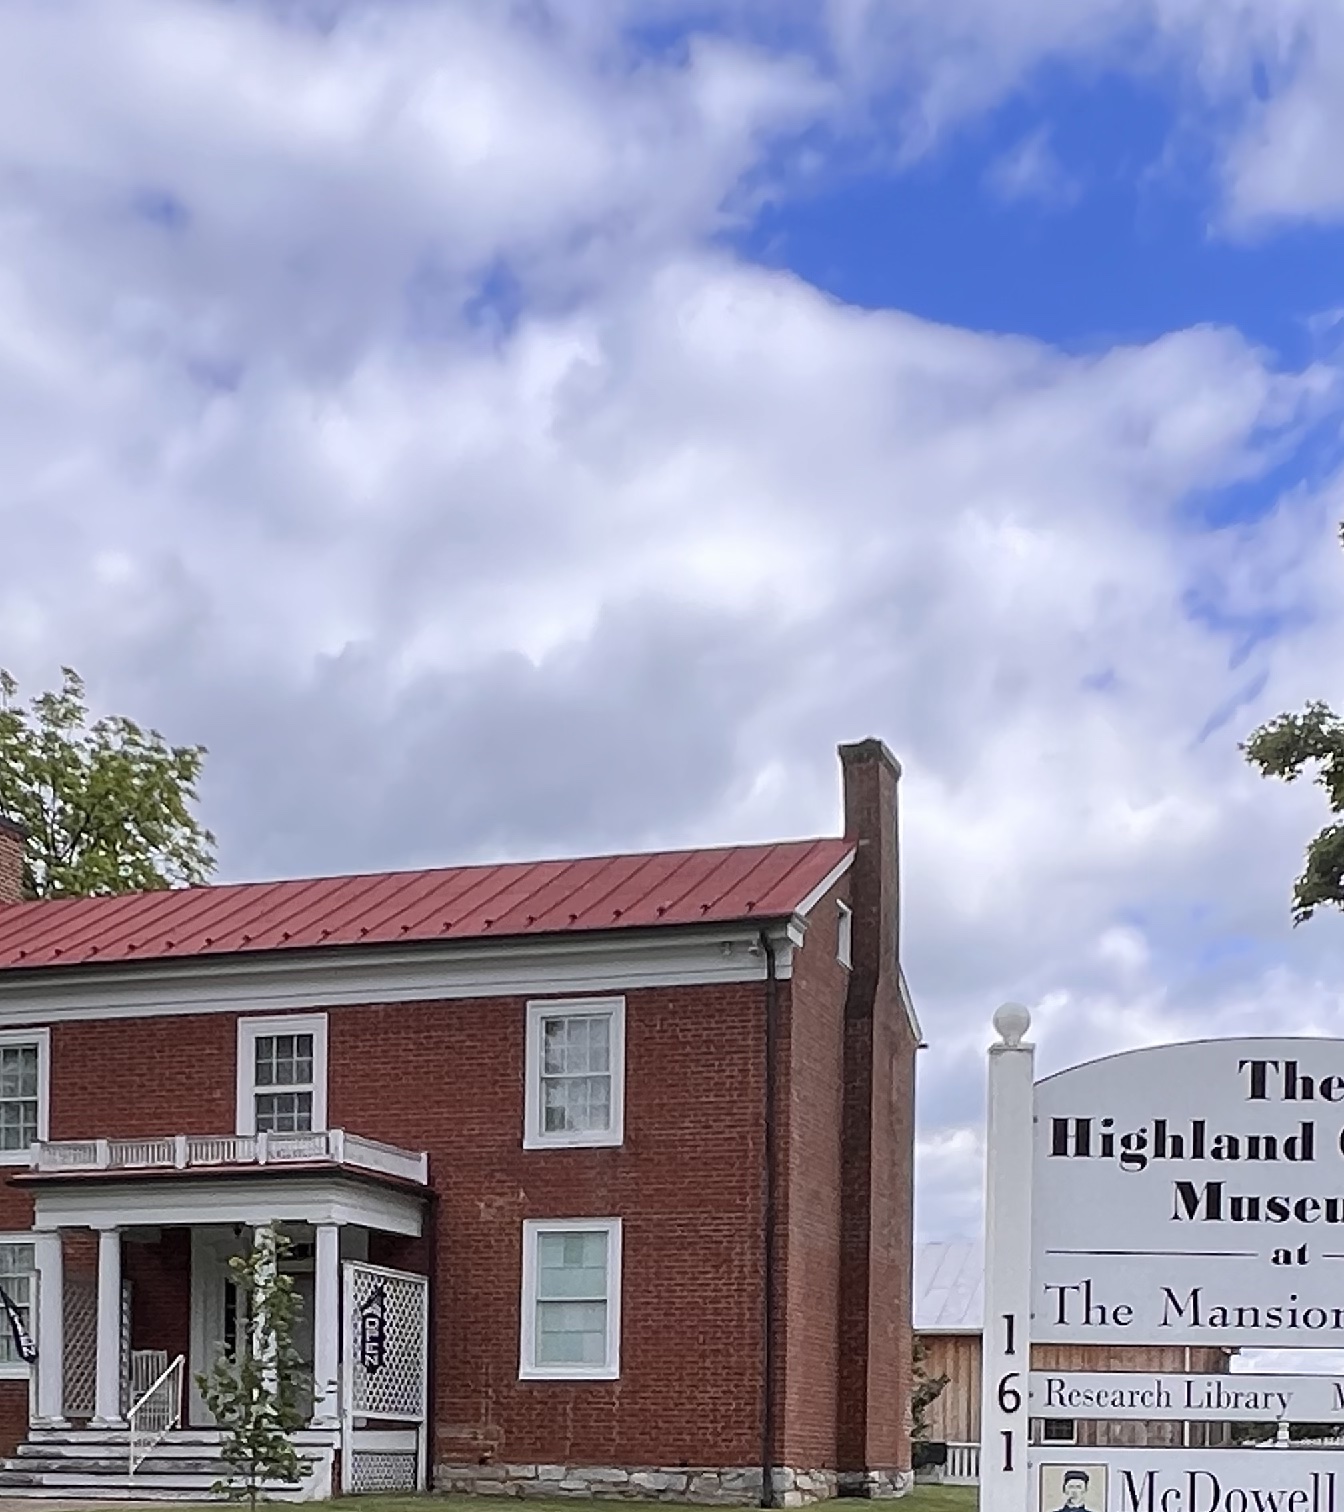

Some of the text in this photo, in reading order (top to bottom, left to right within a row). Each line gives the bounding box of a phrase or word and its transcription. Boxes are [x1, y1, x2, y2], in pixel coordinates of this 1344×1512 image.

[1048, 1116, 1316, 1172] Highland
[1270, 1242, 1310, 1266] at
[1044, 1279, 1134, 1327] The
[364, 1318, 380, 1366] OPEN
[998, 1314, 1022, 1472] 161
[1044, 1378, 1172, 1409] Research
[1184, 1380, 1294, 1420] Library
